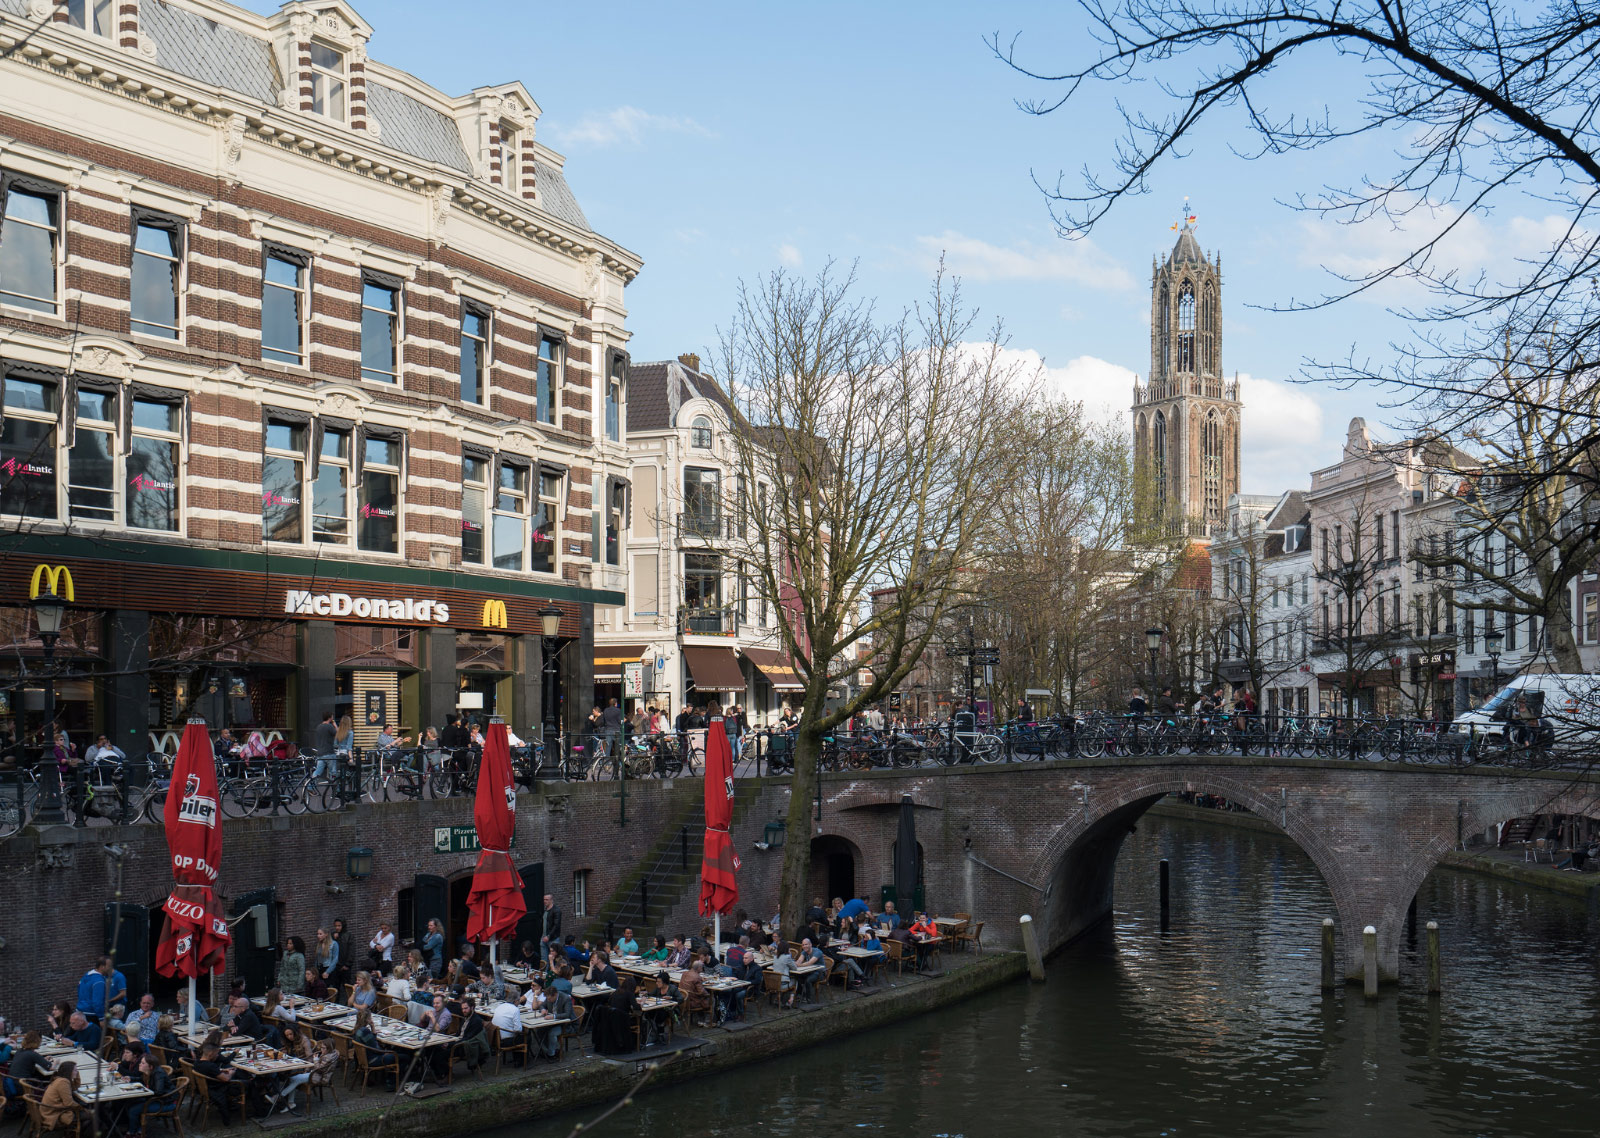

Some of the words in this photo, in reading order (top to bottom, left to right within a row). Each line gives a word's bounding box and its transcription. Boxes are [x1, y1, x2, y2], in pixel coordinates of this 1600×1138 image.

[144, 479, 176, 489] Adlantic
[272, 495, 300, 505] Adlantic
[370, 507, 396, 517] Adlantic
[285, 590, 449, 623] McDonald's
